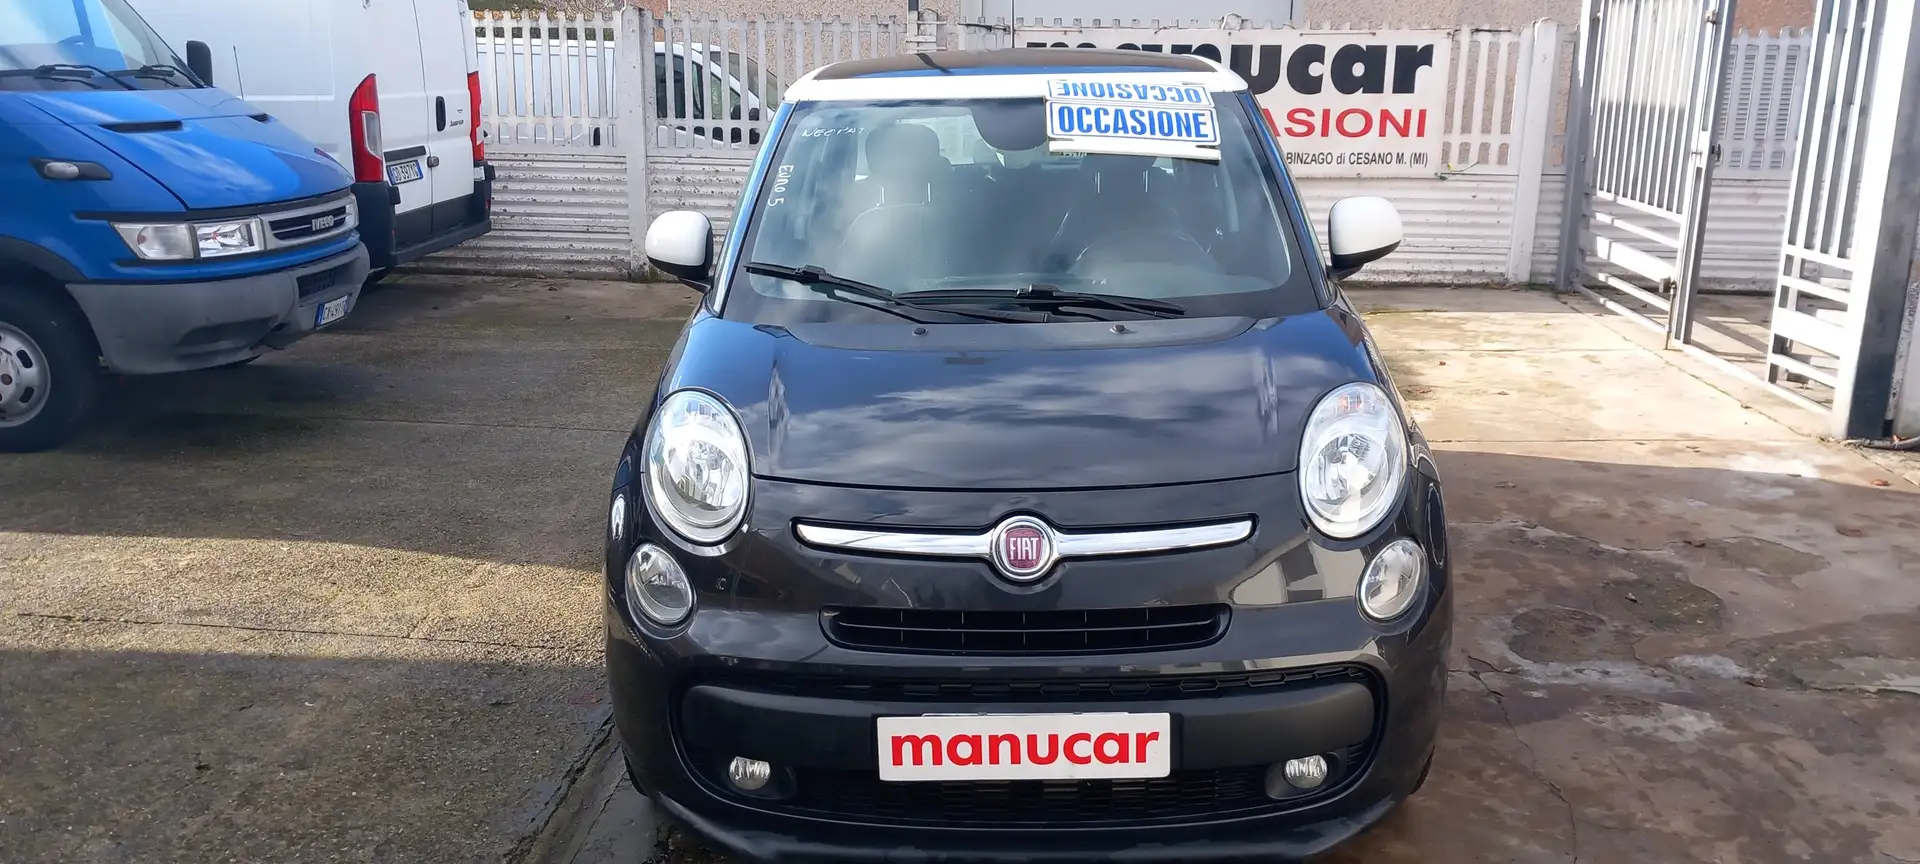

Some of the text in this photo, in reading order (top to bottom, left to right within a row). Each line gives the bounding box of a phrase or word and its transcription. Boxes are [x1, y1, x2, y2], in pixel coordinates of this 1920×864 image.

[1057, 82, 1202, 103] OCCASIONE
[1058, 106, 1209, 138] OCCASIONE
[1286, 152, 1429, 168] BINZAGO di CESANO M. (MI)
[767, 198, 784, 207] 5
[312, 215, 335, 231] IVECO
[1009, 536, 1039, 561] FIAT
[891, 731, 1160, 766] manucar
